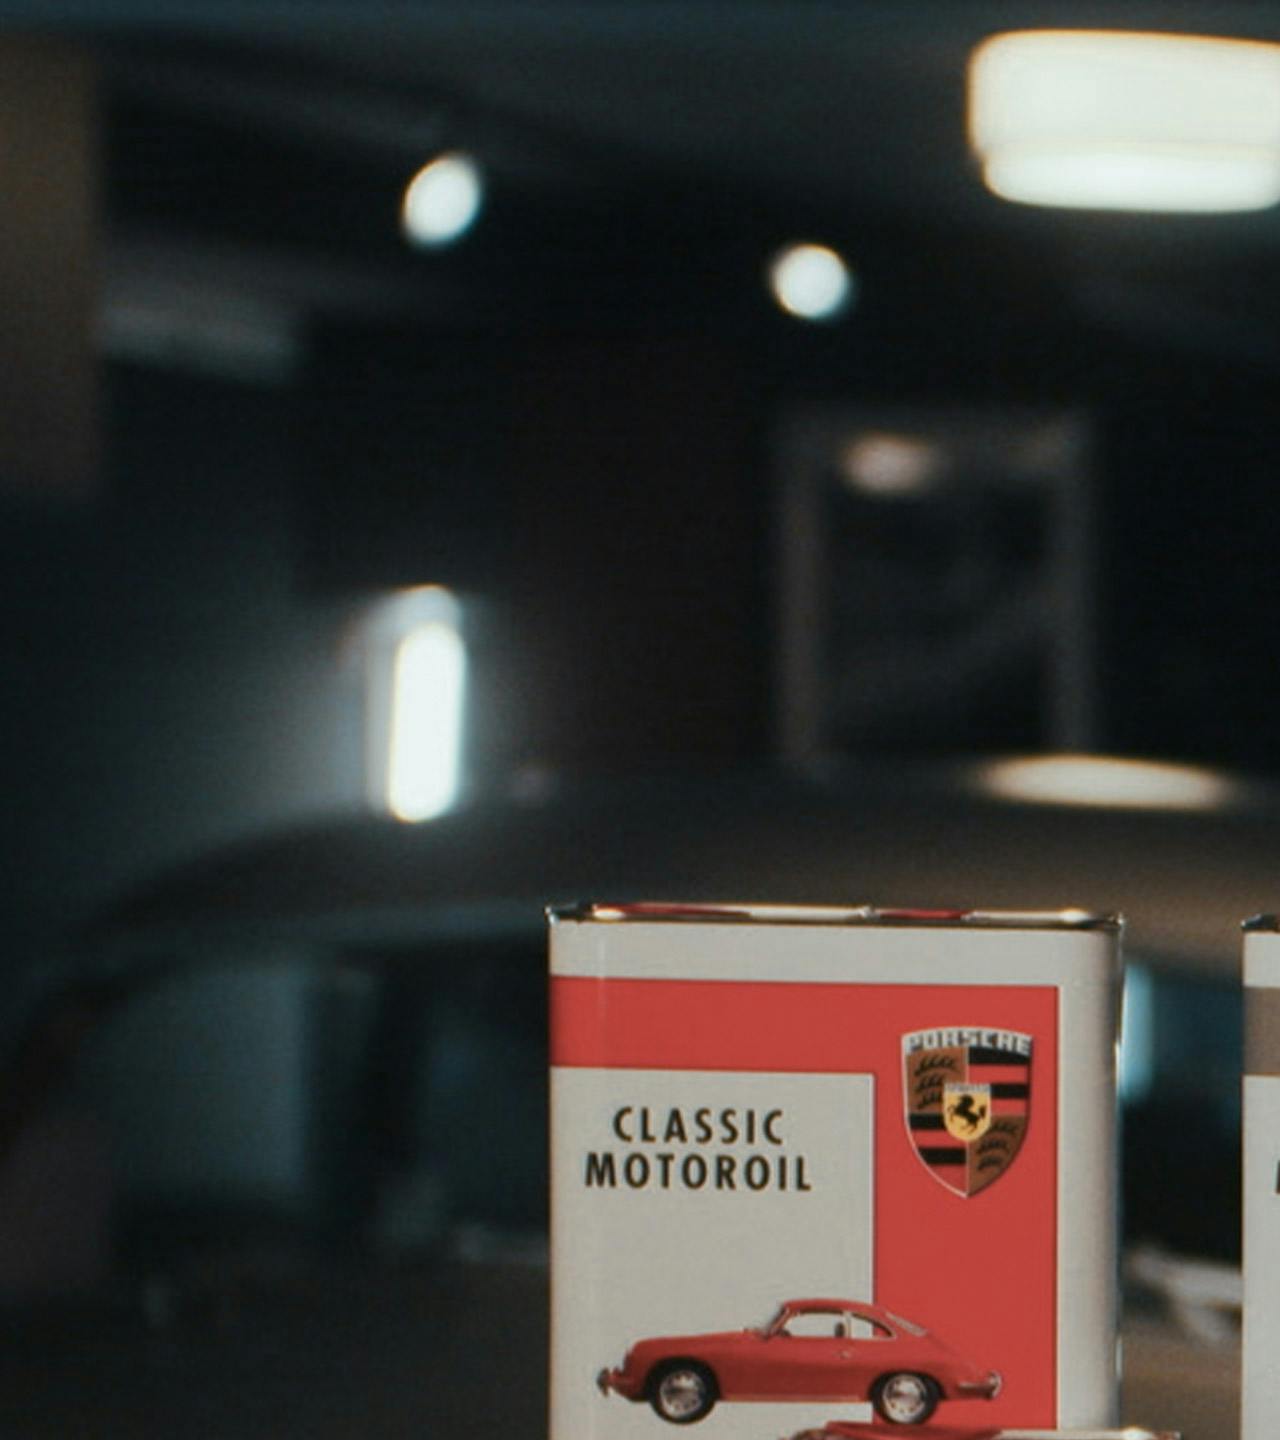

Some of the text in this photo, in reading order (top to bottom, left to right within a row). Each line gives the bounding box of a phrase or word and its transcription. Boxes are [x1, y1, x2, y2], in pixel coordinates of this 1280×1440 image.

[903, 1028, 1031, 1056] PORSCHE
[613, 1106, 783, 1146] CLASSIC
[584, 1152, 812, 1192] MOTOROIL
